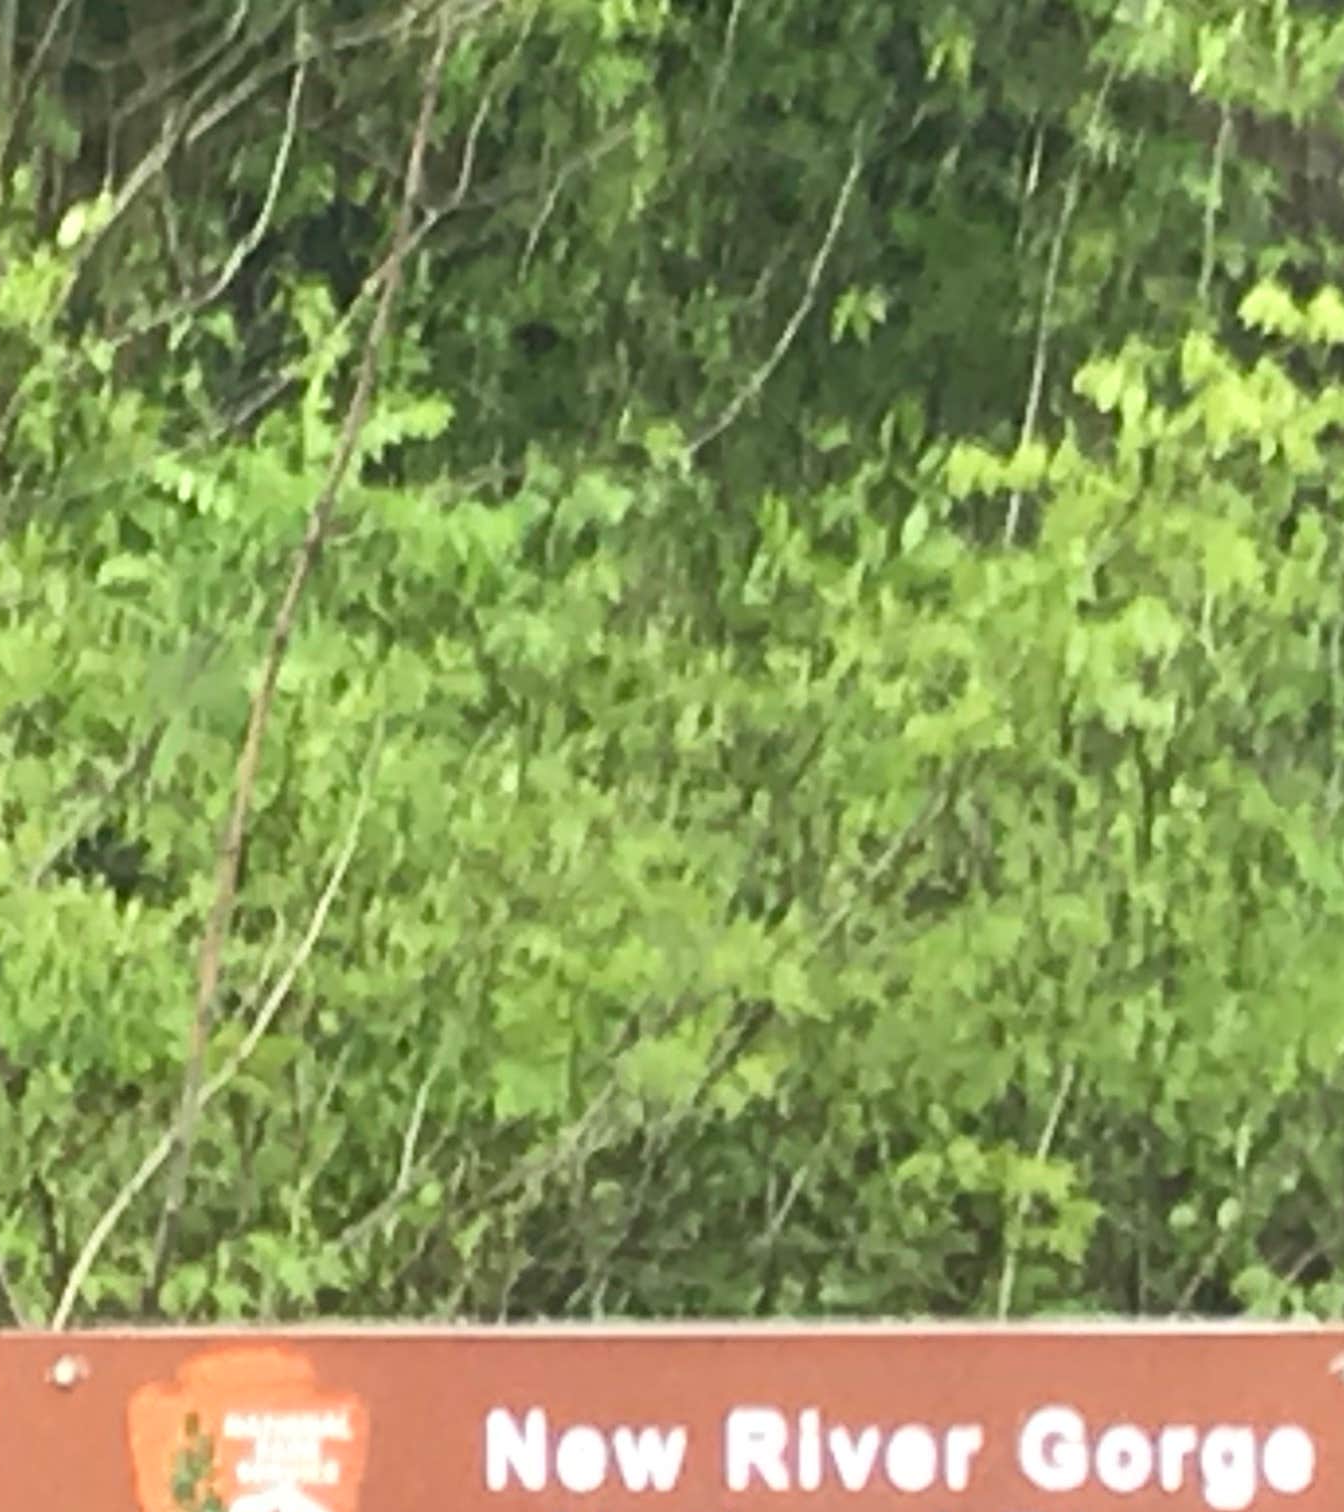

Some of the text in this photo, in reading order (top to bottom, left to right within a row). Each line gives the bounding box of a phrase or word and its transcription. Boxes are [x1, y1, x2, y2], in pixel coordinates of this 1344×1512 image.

[486, 1405, 1316, 1511] New River Gorge
